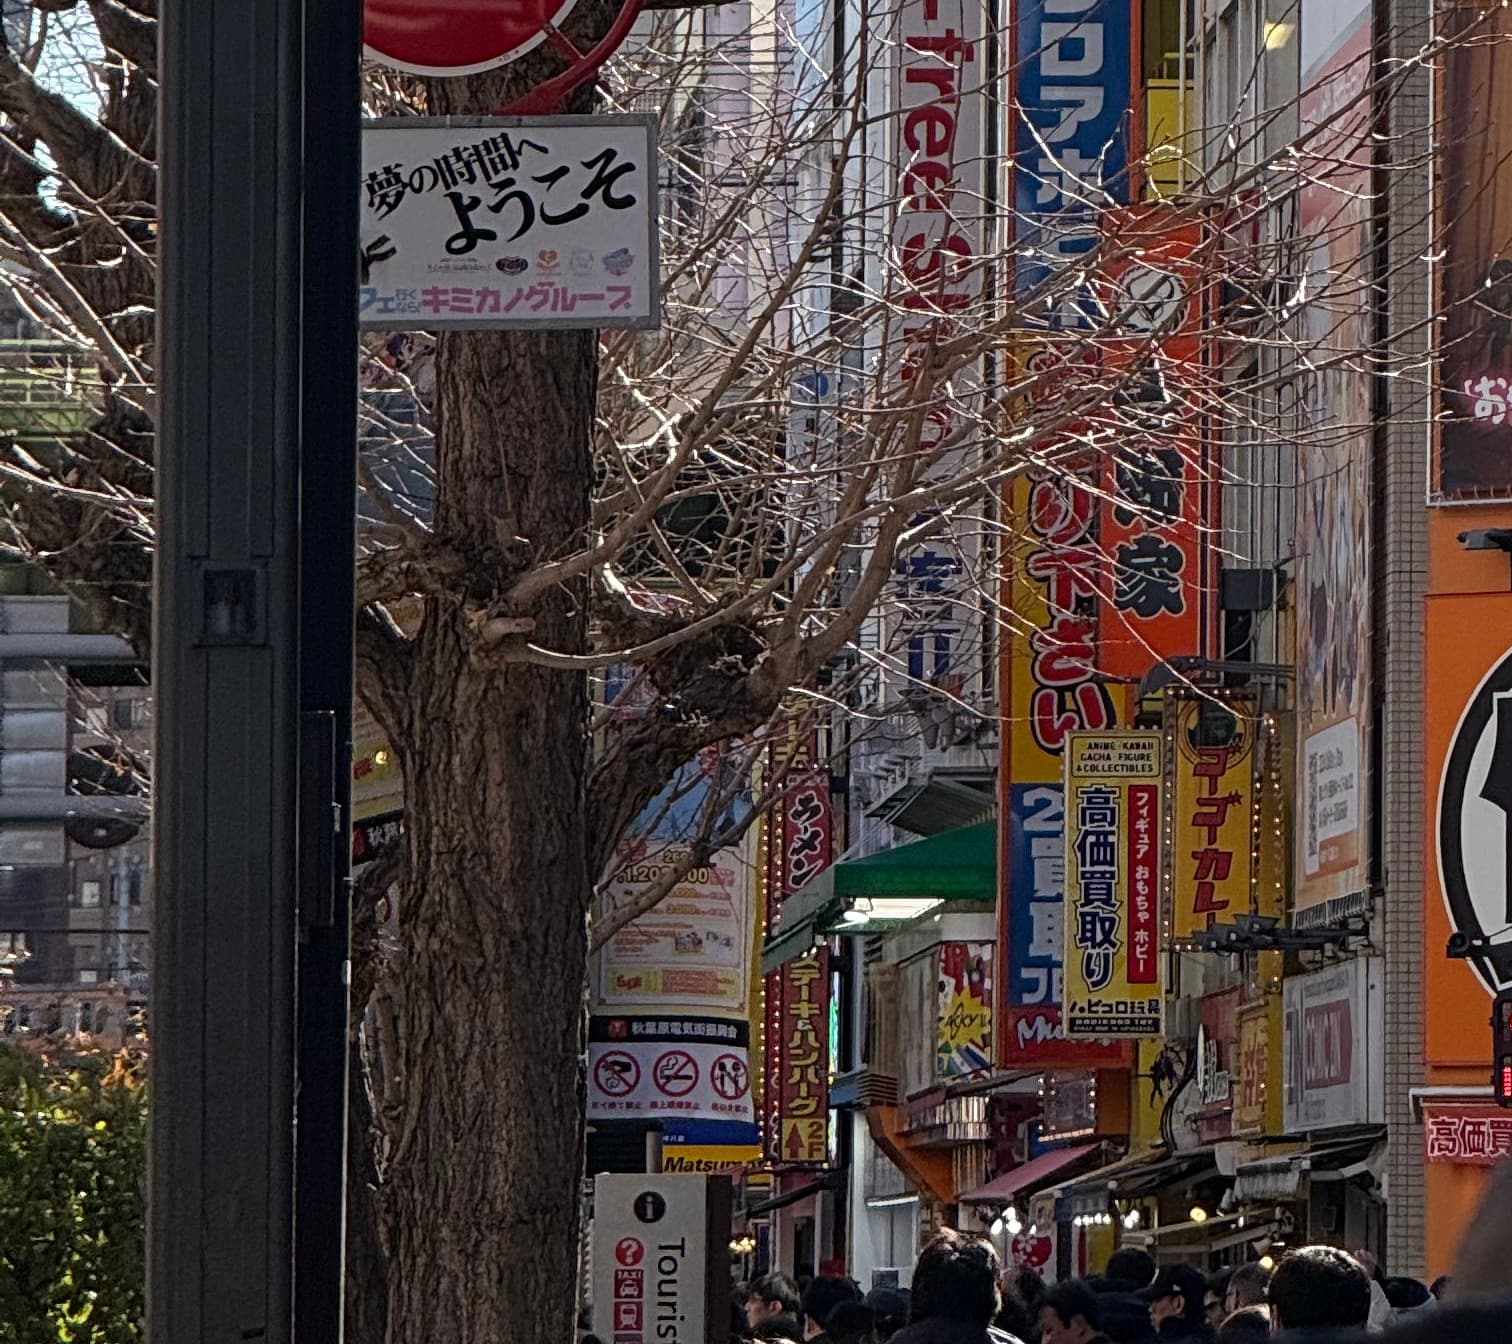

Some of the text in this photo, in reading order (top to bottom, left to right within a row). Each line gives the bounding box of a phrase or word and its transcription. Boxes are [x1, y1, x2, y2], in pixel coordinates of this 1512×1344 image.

[361, 131, 549, 221] 夢の時間へ
[444, 148, 637, 255] ようこそ
[1080, 753, 1153, 762] GACHA FIGURE
[1087, 742, 1116, 751] ANIME
[1074, 784, 1123, 993] 高価買取り
[1134, 792, 1150, 973] フィギュア おもちゃ ホビー
[617, 1270, 642, 1280] TAXI
